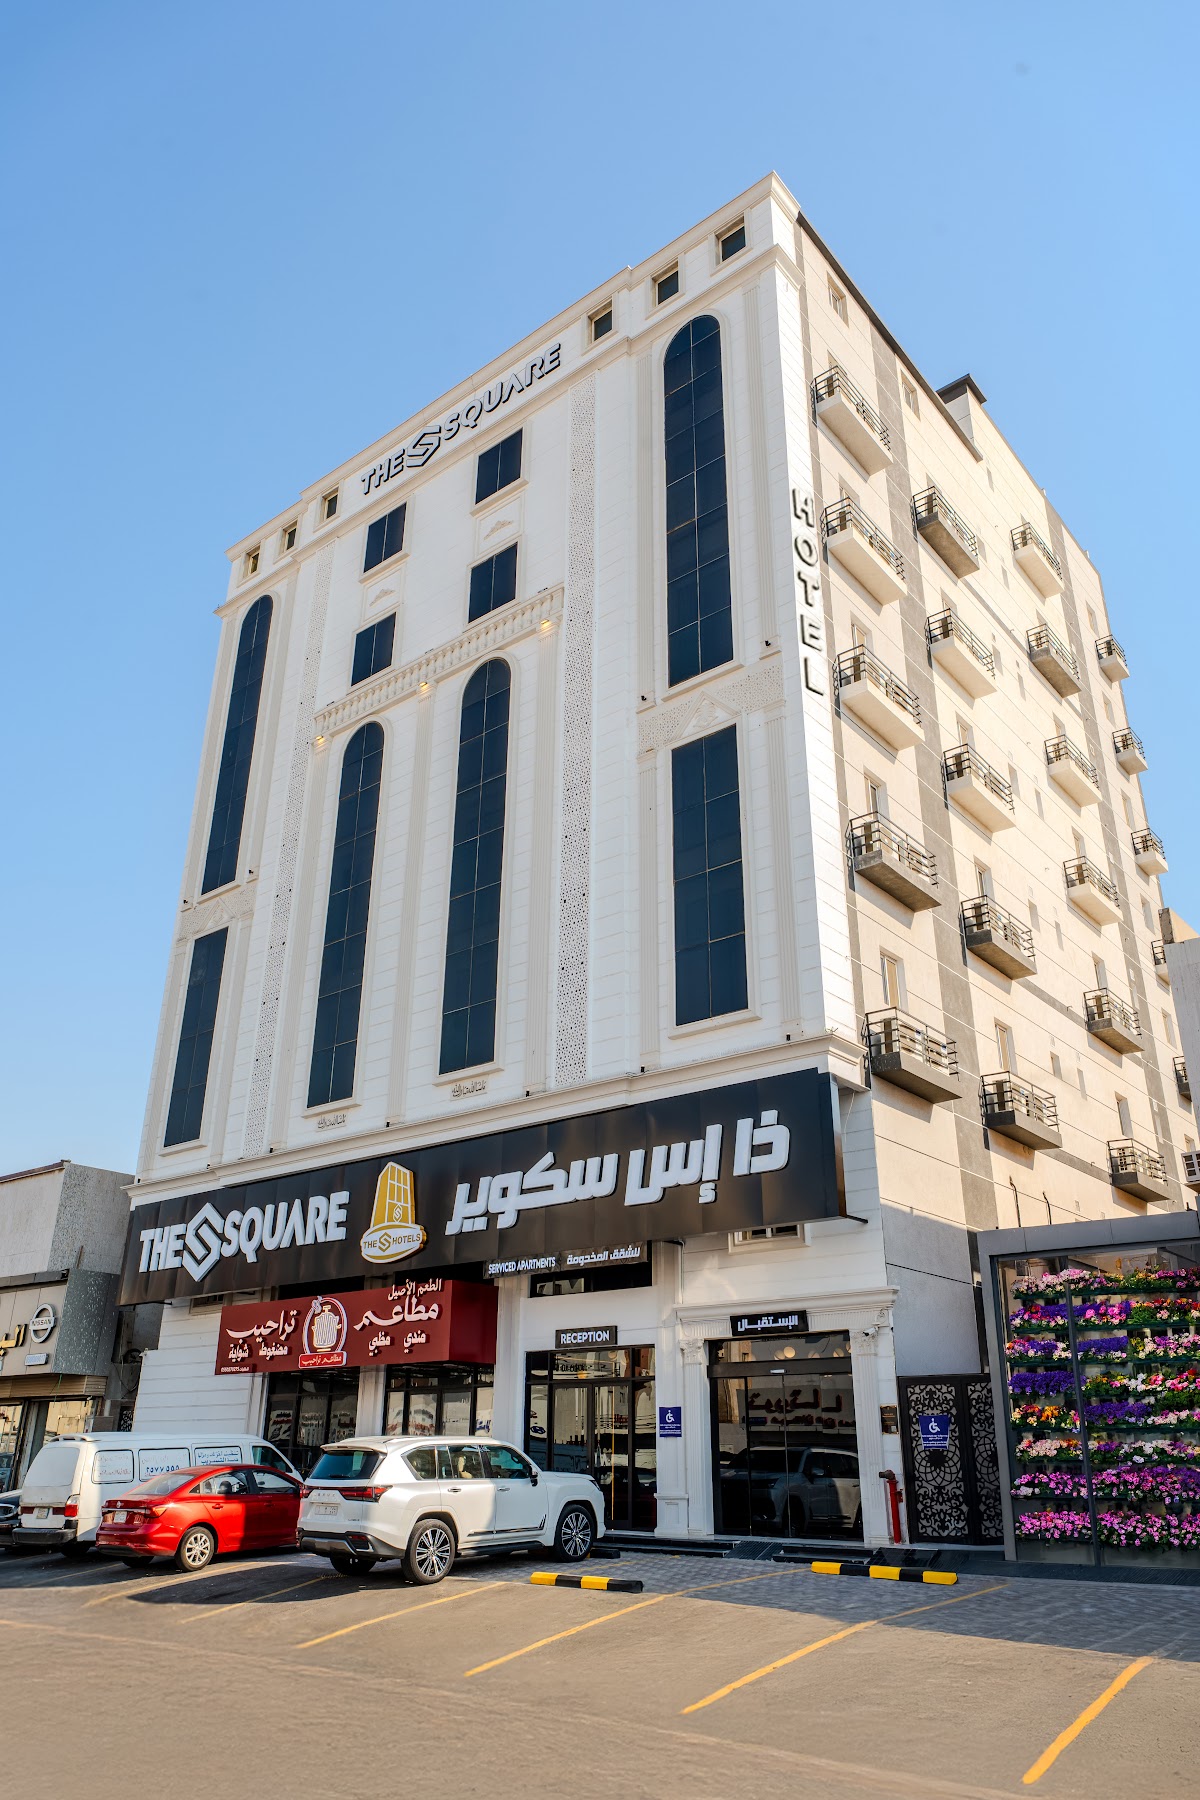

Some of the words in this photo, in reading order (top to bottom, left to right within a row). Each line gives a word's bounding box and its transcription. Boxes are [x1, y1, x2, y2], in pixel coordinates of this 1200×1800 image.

[361, 448, 405, 495] THE
[443, 343, 561, 440] SQUARE
[792, 488, 824, 696] HOTEL
[733, 1109, 790, 1176] ذا
[624, 1124, 723, 1206] إس
[445, 1151, 618, 1236] سكوير
[139, 1223, 187, 1273] THE
[221, 1191, 349, 1264] SQUARE
[363, 1240, 378, 1249] THE
[392, 1233, 420, 1245] HOTELS
[488, 1261, 516, 1274] SERVICED
[516, 1256, 556, 1271] APARTMENTS
[566, 1250, 608, 1267] المخدومة
[388, 1279, 416, 1301] الأصيل
[417, 1278, 442, 1297] الطعم
[32, 1319, 51, 1327] NISSAN
[353, 1295, 439, 1331] مطاعم
[403, 1329, 427, 1353] مندي
[560, 1330, 610, 1344] RECEPTION
